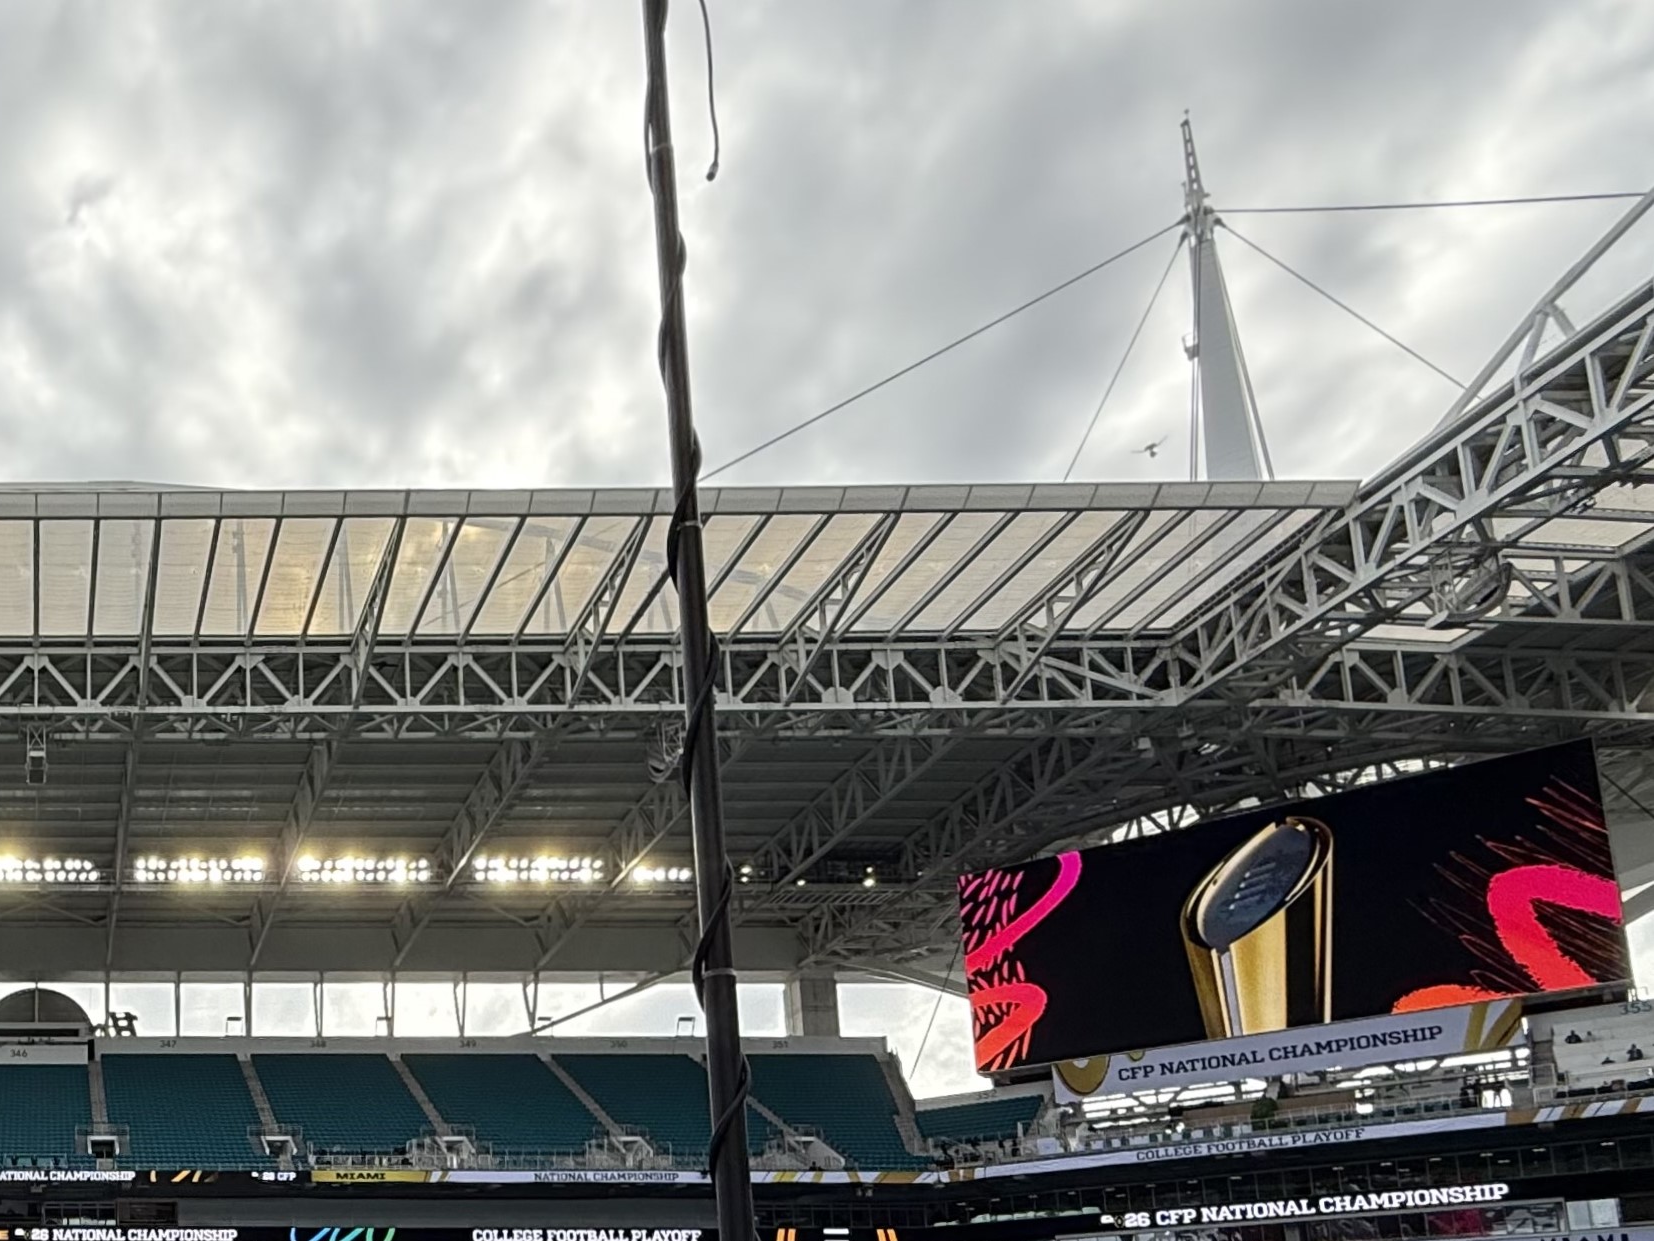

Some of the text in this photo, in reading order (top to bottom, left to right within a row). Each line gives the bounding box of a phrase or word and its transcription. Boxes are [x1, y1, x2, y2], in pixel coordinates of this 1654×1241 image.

[1618, 1002, 1653, 1016] 355
[9, 1048, 28, 1059] 346
[1118, 1024, 1444, 1082] CFP NATIONAL CHAMPIONSHIP
[1136, 1127, 1366, 1162] COLLEGE FOOTBALL PLAYOFF
[49, 1171, 136, 1183] CHAMPIONSHIP
[335, 1171, 386, 1181] MIAMI
[533, 1171, 680, 1183] NATIONAL CHAMPIONSHIP
[1155, 1209, 1198, 1227] CFP
[1199, 1198, 1317, 1224] NATIONAL
[1318, 1183, 1510, 1214] CHAMPIONSHIP
